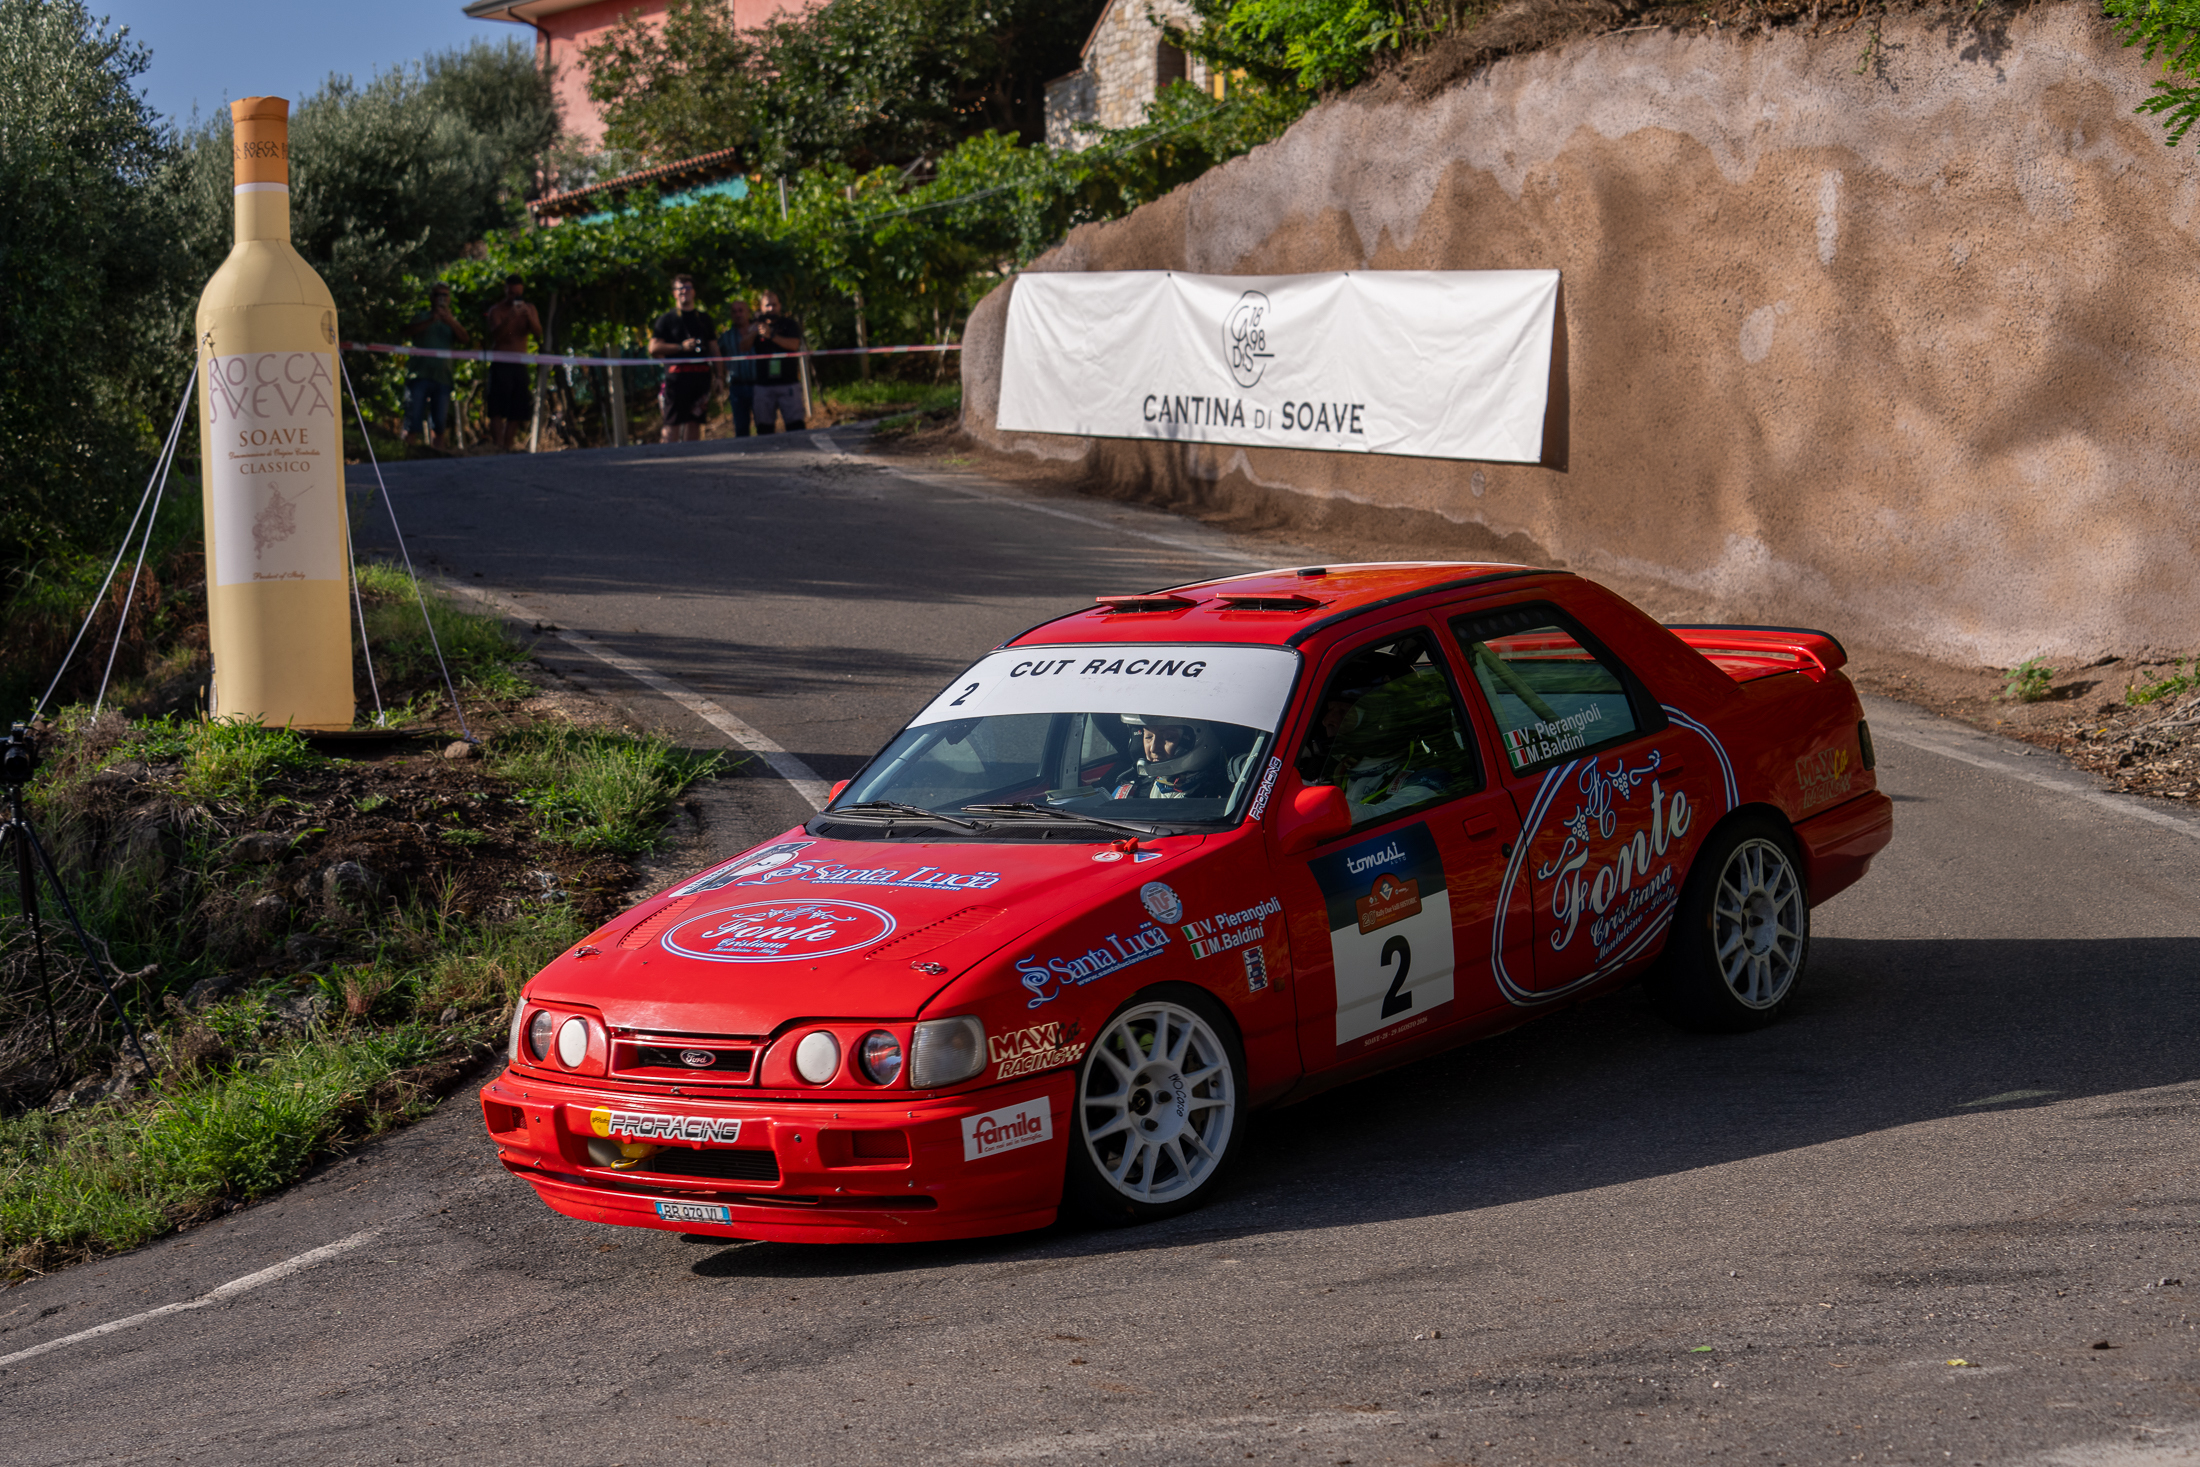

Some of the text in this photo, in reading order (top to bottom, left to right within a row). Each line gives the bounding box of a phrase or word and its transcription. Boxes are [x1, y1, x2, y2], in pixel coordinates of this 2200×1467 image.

[244, 141, 279, 151] ROCCA
[1250, 329, 1266, 351] 98
[208, 352, 333, 390] ROCCA
[1143, 394, 1365, 434] CANTINA DI SOAVE
[239, 428, 309, 447] SOAVE
[240, 461, 310, 475] CLASSICO
[1010, 658, 1207, 678] CUT RACING
[950, 682, 980, 707] 2
[1518, 703, 1602, 744] V. Pierangioli
[1249, 756, 1283, 821] PRORACING
[1347, 841, 1405, 874] tomasi
[1390, 856, 1407, 866] AUTO
[1551, 779, 1692, 951] Fonte
[800, 863, 1001, 889] Santa Lucia
[1199, 896, 1282, 935] V. Pierangioli
[1590, 863, 1672, 947] Cristiana
[701, 918, 837, 942] Fonte
[1047, 921, 1171, 986] Santa Lucia
[1380, 935, 1413, 1020] 2
[988, 1020, 1063, 1063] MAXI
[685, 1052, 708, 1064] Ford
[996, 1049, 1066, 1080] RACING
[610, 1114, 740, 1141] PRORACING
[972, 1112, 1042, 1154] famila
